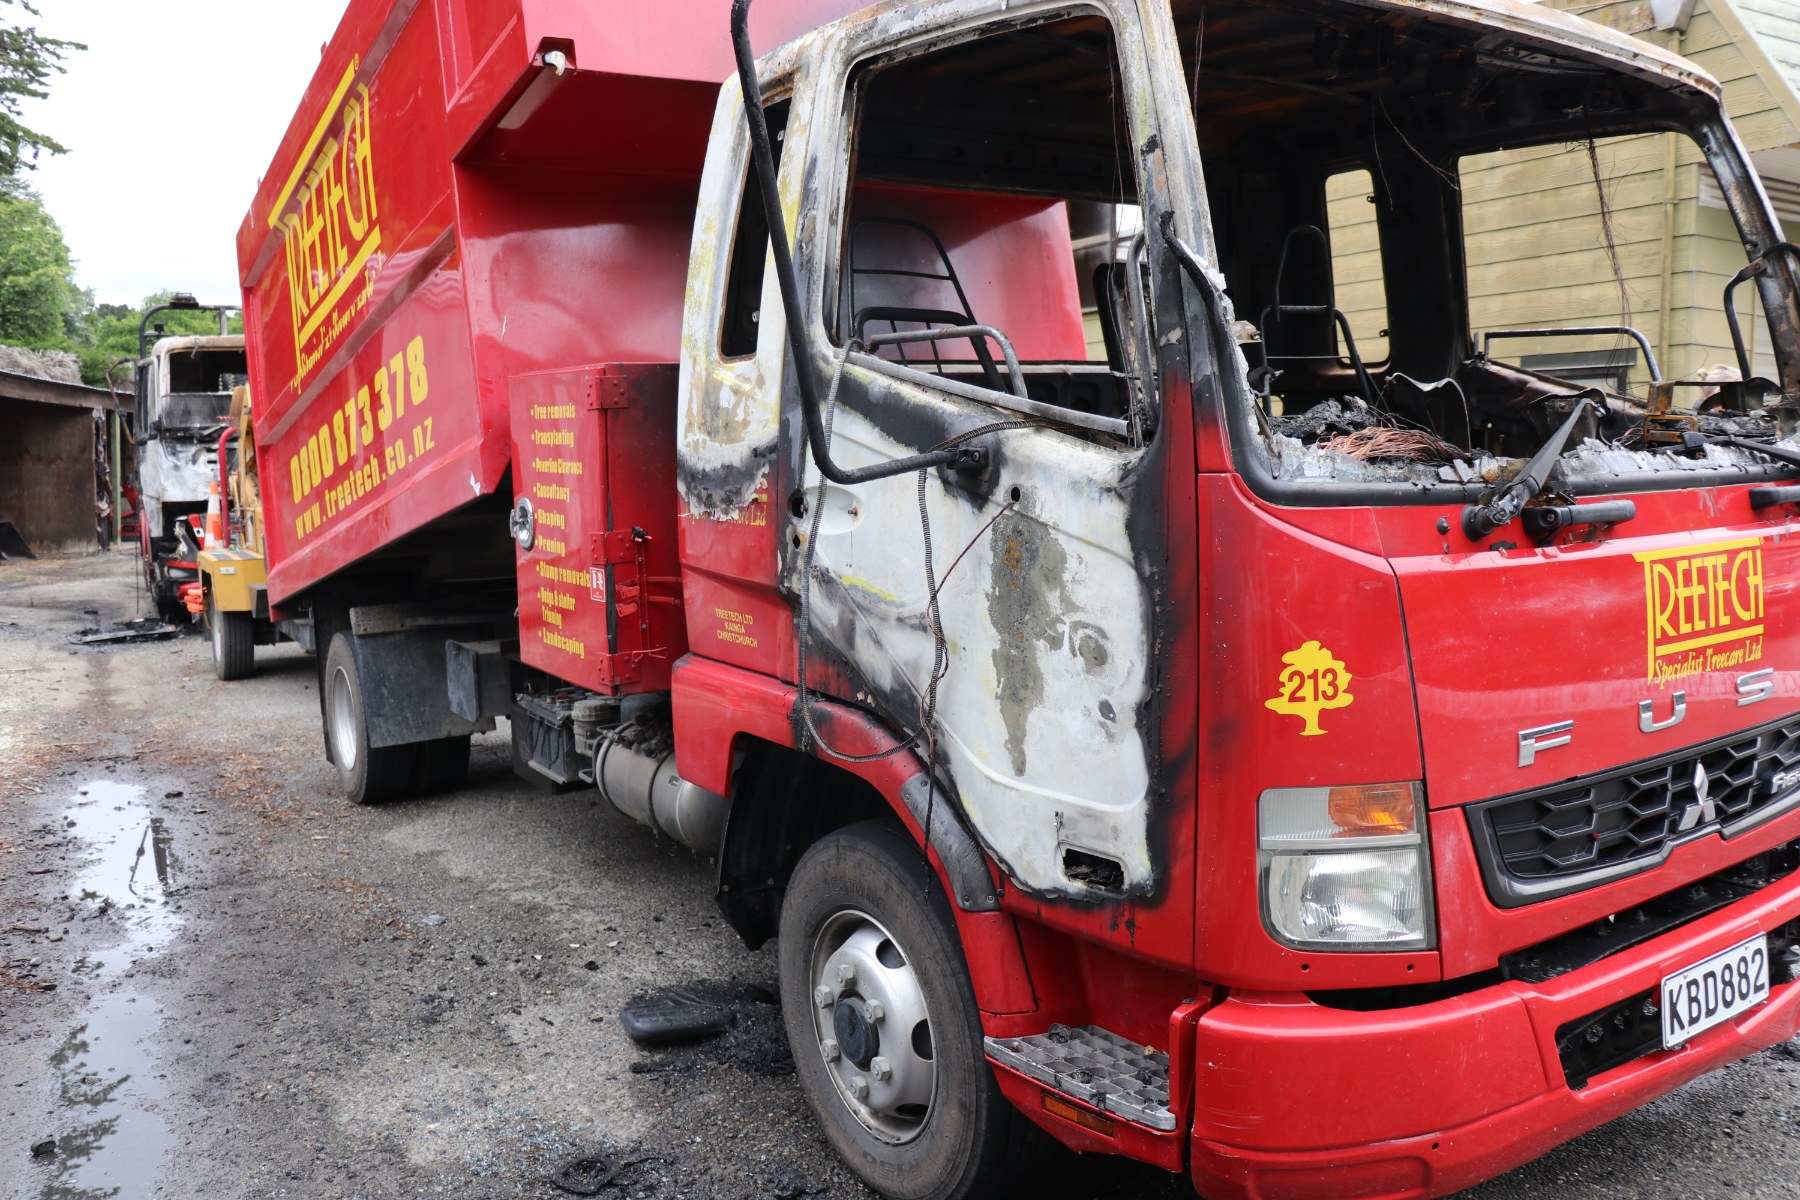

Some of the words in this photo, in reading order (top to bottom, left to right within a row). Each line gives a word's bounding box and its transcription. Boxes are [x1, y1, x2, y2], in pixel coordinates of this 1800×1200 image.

[268, 58, 378, 382] TREETECH
[290, 423, 334, 505] 0800
[333, 384, 374, 466] 873
[374, 335, 428, 431] 378
[534, 404, 547, 419] Tree
[548, 402, 576, 419] removals
[535, 429, 574, 448] Transplanting
[295, 416, 435, 540] www.treetech.co.nz
[538, 509, 565, 530] Shaping
[538, 535, 565, 557] Pruning
[540, 561, 558, 582] Stump
[559, 566, 591, 588] removals
[715, 608, 743, 622] TREETECH
[743, 614, 754, 625] LTD
[1632, 537, 1764, 686] TREETECH
[543, 627, 585, 659] Landscaping
[717, 629, 758, 648] CHRISTCHURCH
[1654, 652, 1704, 690] Specialist
[1705, 648, 1744, 672] Treecare
[1744, 635, 1763, 663] Ltd
[1287, 667, 1340, 704] 213
[1668, 947, 1766, 1036] KBD882
